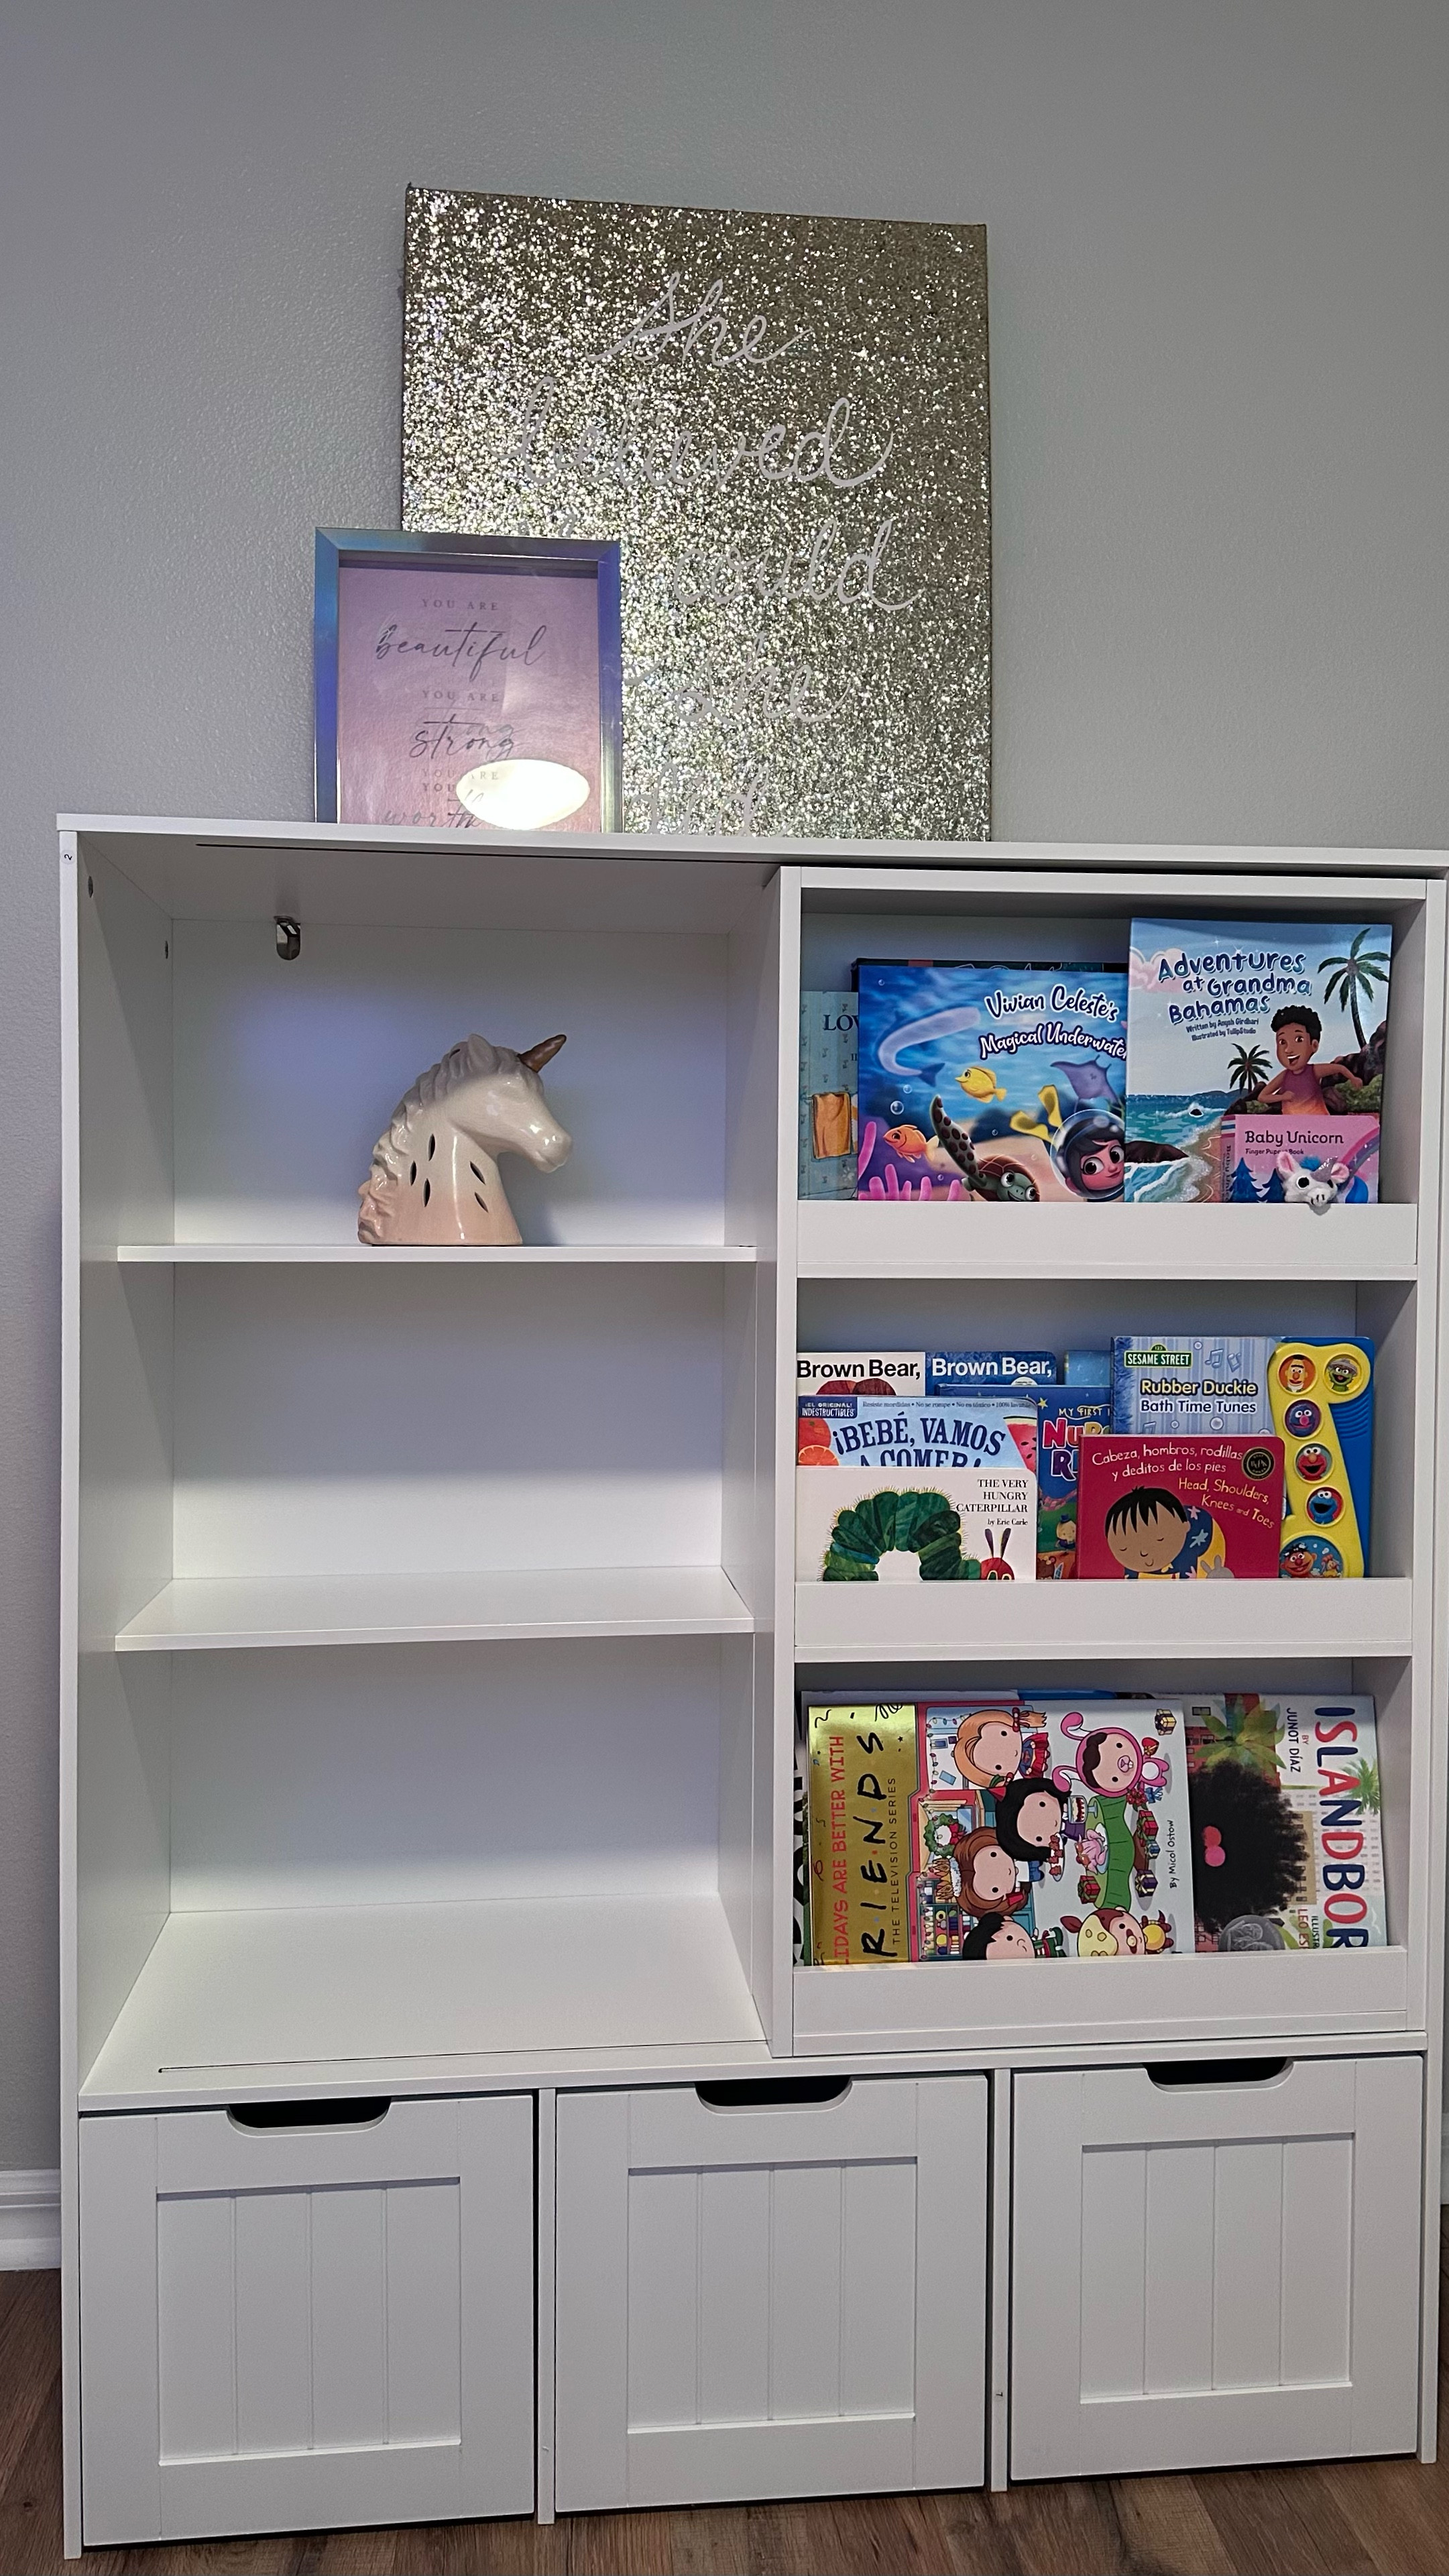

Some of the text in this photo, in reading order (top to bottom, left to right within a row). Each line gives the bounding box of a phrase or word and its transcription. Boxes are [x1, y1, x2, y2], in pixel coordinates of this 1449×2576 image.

[587, 270, 814, 368] She
[486, 376, 894, 490] believed
[672, 518, 925, 611] could
[422, 599, 498, 611] YOU ARE
[375, 621, 547, 682] beautiful
[422, 689, 499, 702] YOU ARE
[410, 714, 519, 761] strong
[1157, 952, 1306, 983] Adventures
[1182, 972, 1313, 997] at Grandma
[986, 985, 1119, 1021] Vivian Celeste's
[1169, 995, 1271, 1025] Bahamas
[979, 1025, 1044, 1059] Magical
[1244, 1130, 1344, 1147] Baby Unicorn
[1245, 1147, 1265, 1156] Finger
[797, 1359, 921, 1380] Brown Bear,
[931, 1356, 1053, 1378] Brown Bear,
[1127, 1353, 1190, 1365] SESAME STREET
[1141, 1379, 1257, 1394] Rubber Duckie
[802, 1408, 855, 1417] INDESTRUCTIBLES
[1059, 1408, 1074, 1417] MY
[1077, 1406, 1103, 1416] FIRST
[1141, 1399, 1256, 1412] Bath Time Tunes
[919, 1417, 1006, 1456] VAMOS
[1092, 1442, 1243, 1466] Cabeza, hombros, rodillas
[1112, 1458, 1227, 1482] y deditos de los pies
[977, 1479, 1029, 1488] THE VERY
[983, 1492, 1028, 1500] HUNGRY
[1178, 1477, 1270, 1505] Head, Shoulders,
[955, 1503, 1028, 1513] CATERPILLAR
[1202, 1494, 1275, 1529] Knees and Toes
[987, 1518, 995, 1526] by
[996, 1518, 1010, 1526] Eric
[1287, 1707, 1301, 1773] JUNOT DÍAZ
[1302, 1735, 1310, 1745] BY
[829, 1736, 845, 1783] WITH
[830, 1789, 847, 1852] BETTER
[1167, 1819, 1175, 1847] Ostow
[888, 1777, 901, 1944] THE TELEVISION SERIES
[1165, 1850, 1176, 1874] Micol
[833, 1858, 848, 1894] ARE
[1297, 1909, 1310, 1949] LEO ES
[1311, 1915, 1320, 1949] ILLUSTR
